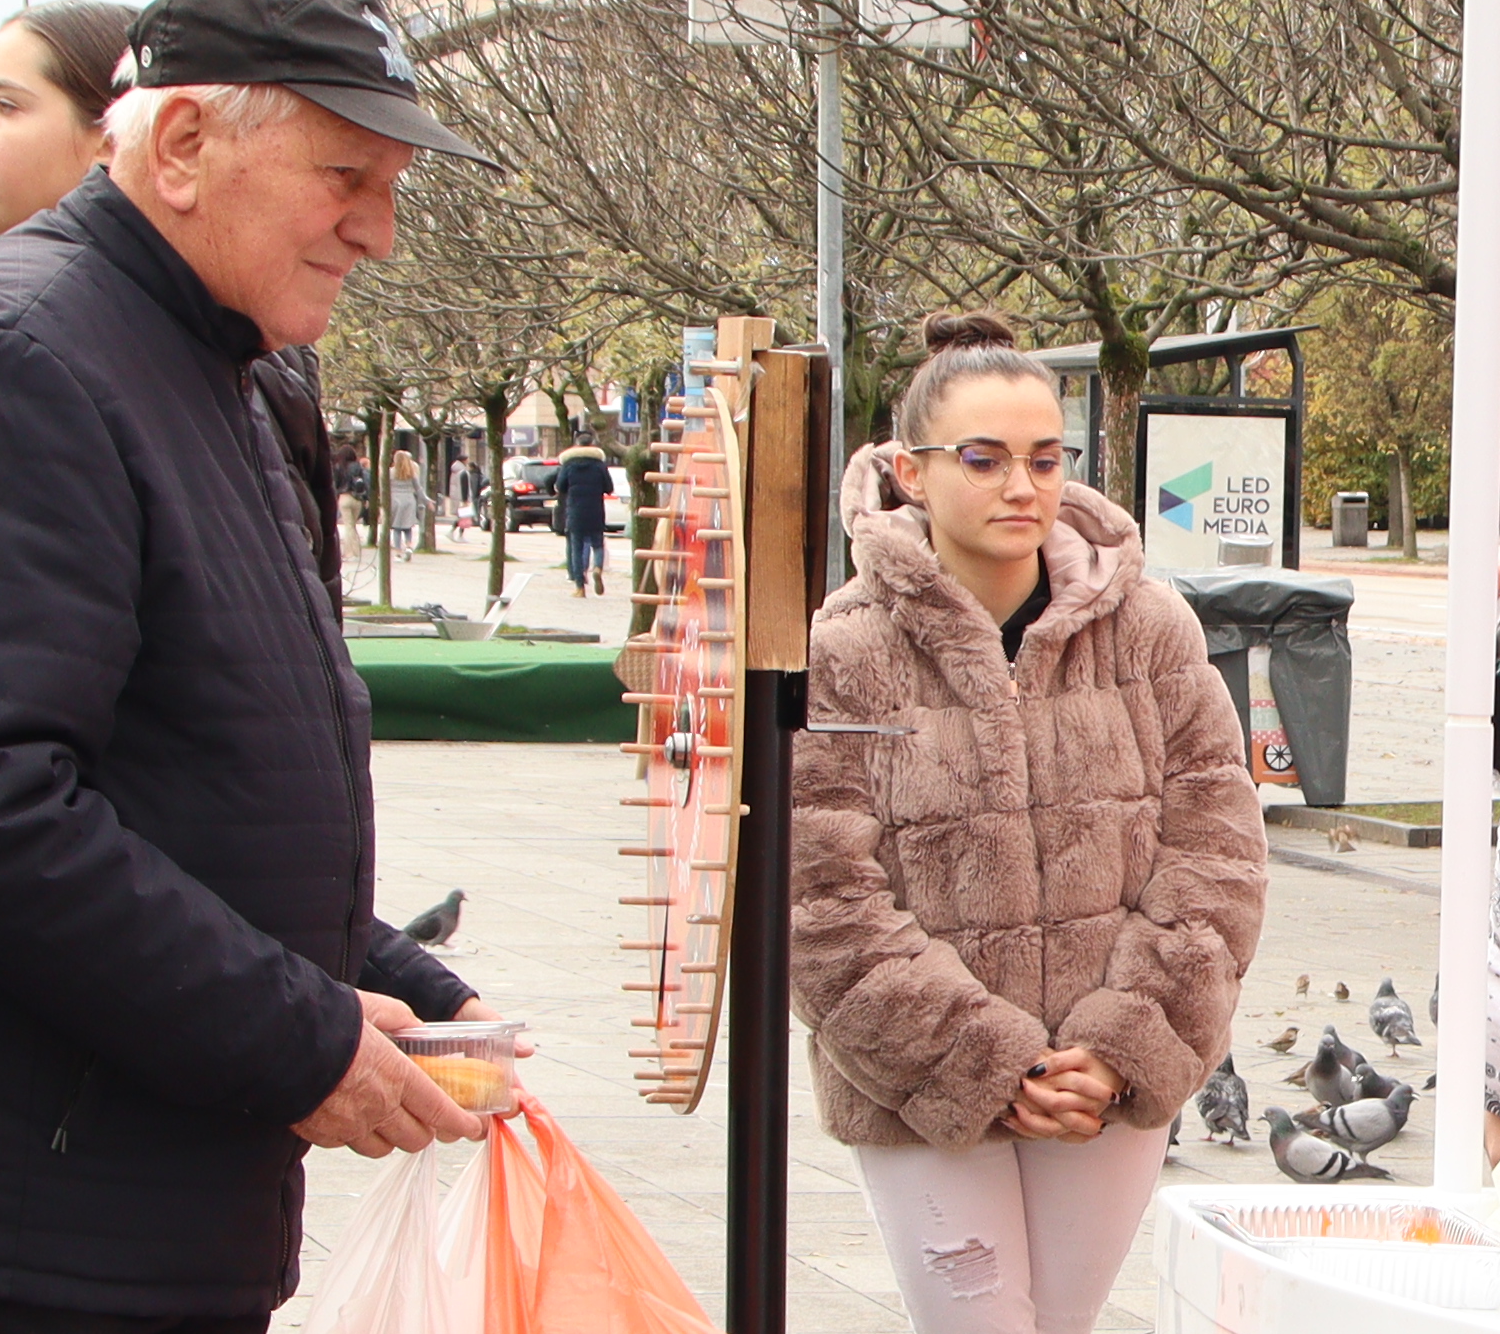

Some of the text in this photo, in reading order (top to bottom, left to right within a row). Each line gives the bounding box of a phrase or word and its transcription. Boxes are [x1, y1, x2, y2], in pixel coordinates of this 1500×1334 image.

[1227, 476, 1270, 494] LED
[1213, 497, 1270, 514] EURO
[1203, 518, 1269, 535] MEDIA
